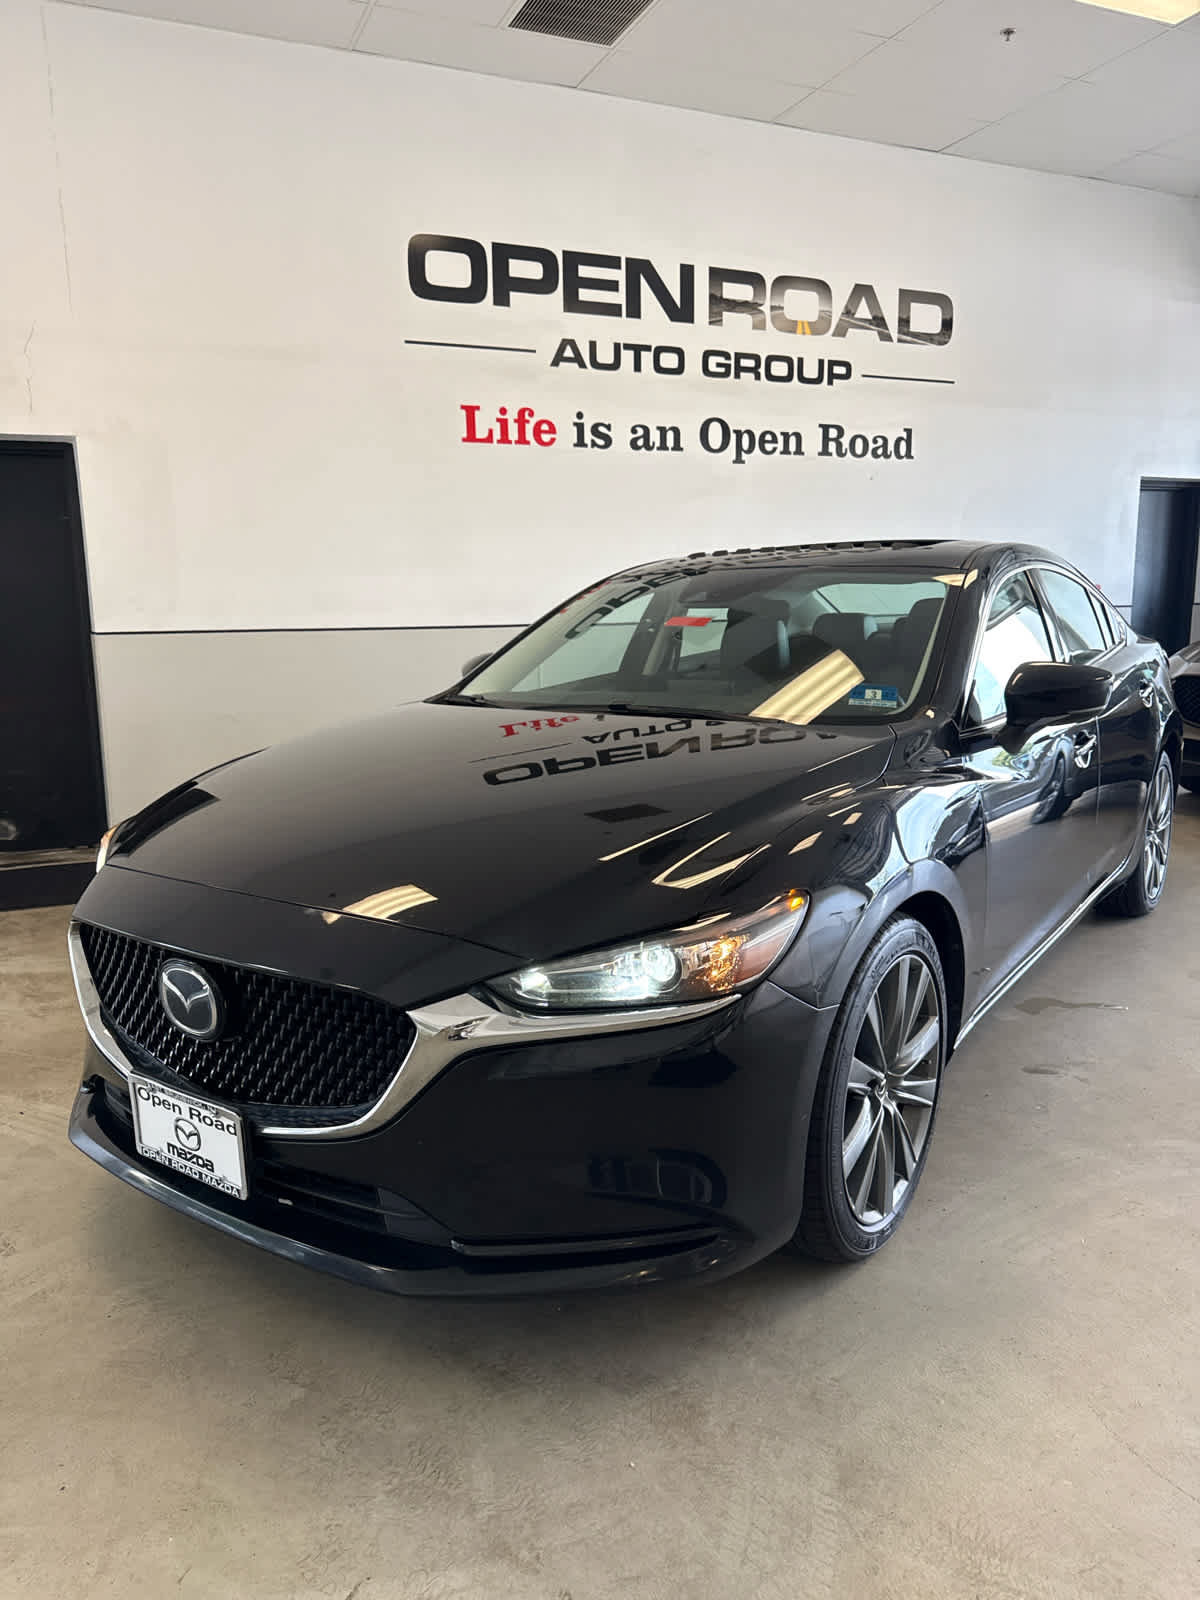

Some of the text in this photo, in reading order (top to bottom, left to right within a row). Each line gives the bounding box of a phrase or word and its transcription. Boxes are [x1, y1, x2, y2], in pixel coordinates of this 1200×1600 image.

[407, 233, 954, 347] OPEN ROAD
[549, 338, 852, 386] AUTO GROUP
[460, 404, 915, 465] Life is an Open Road
[138, 1086, 182, 1116] Open
[189, 1108, 237, 1136] Road
[142, 1148, 240, 1198] OPEN ROAD MAZDA
[167, 1141, 215, 1173] mazda
